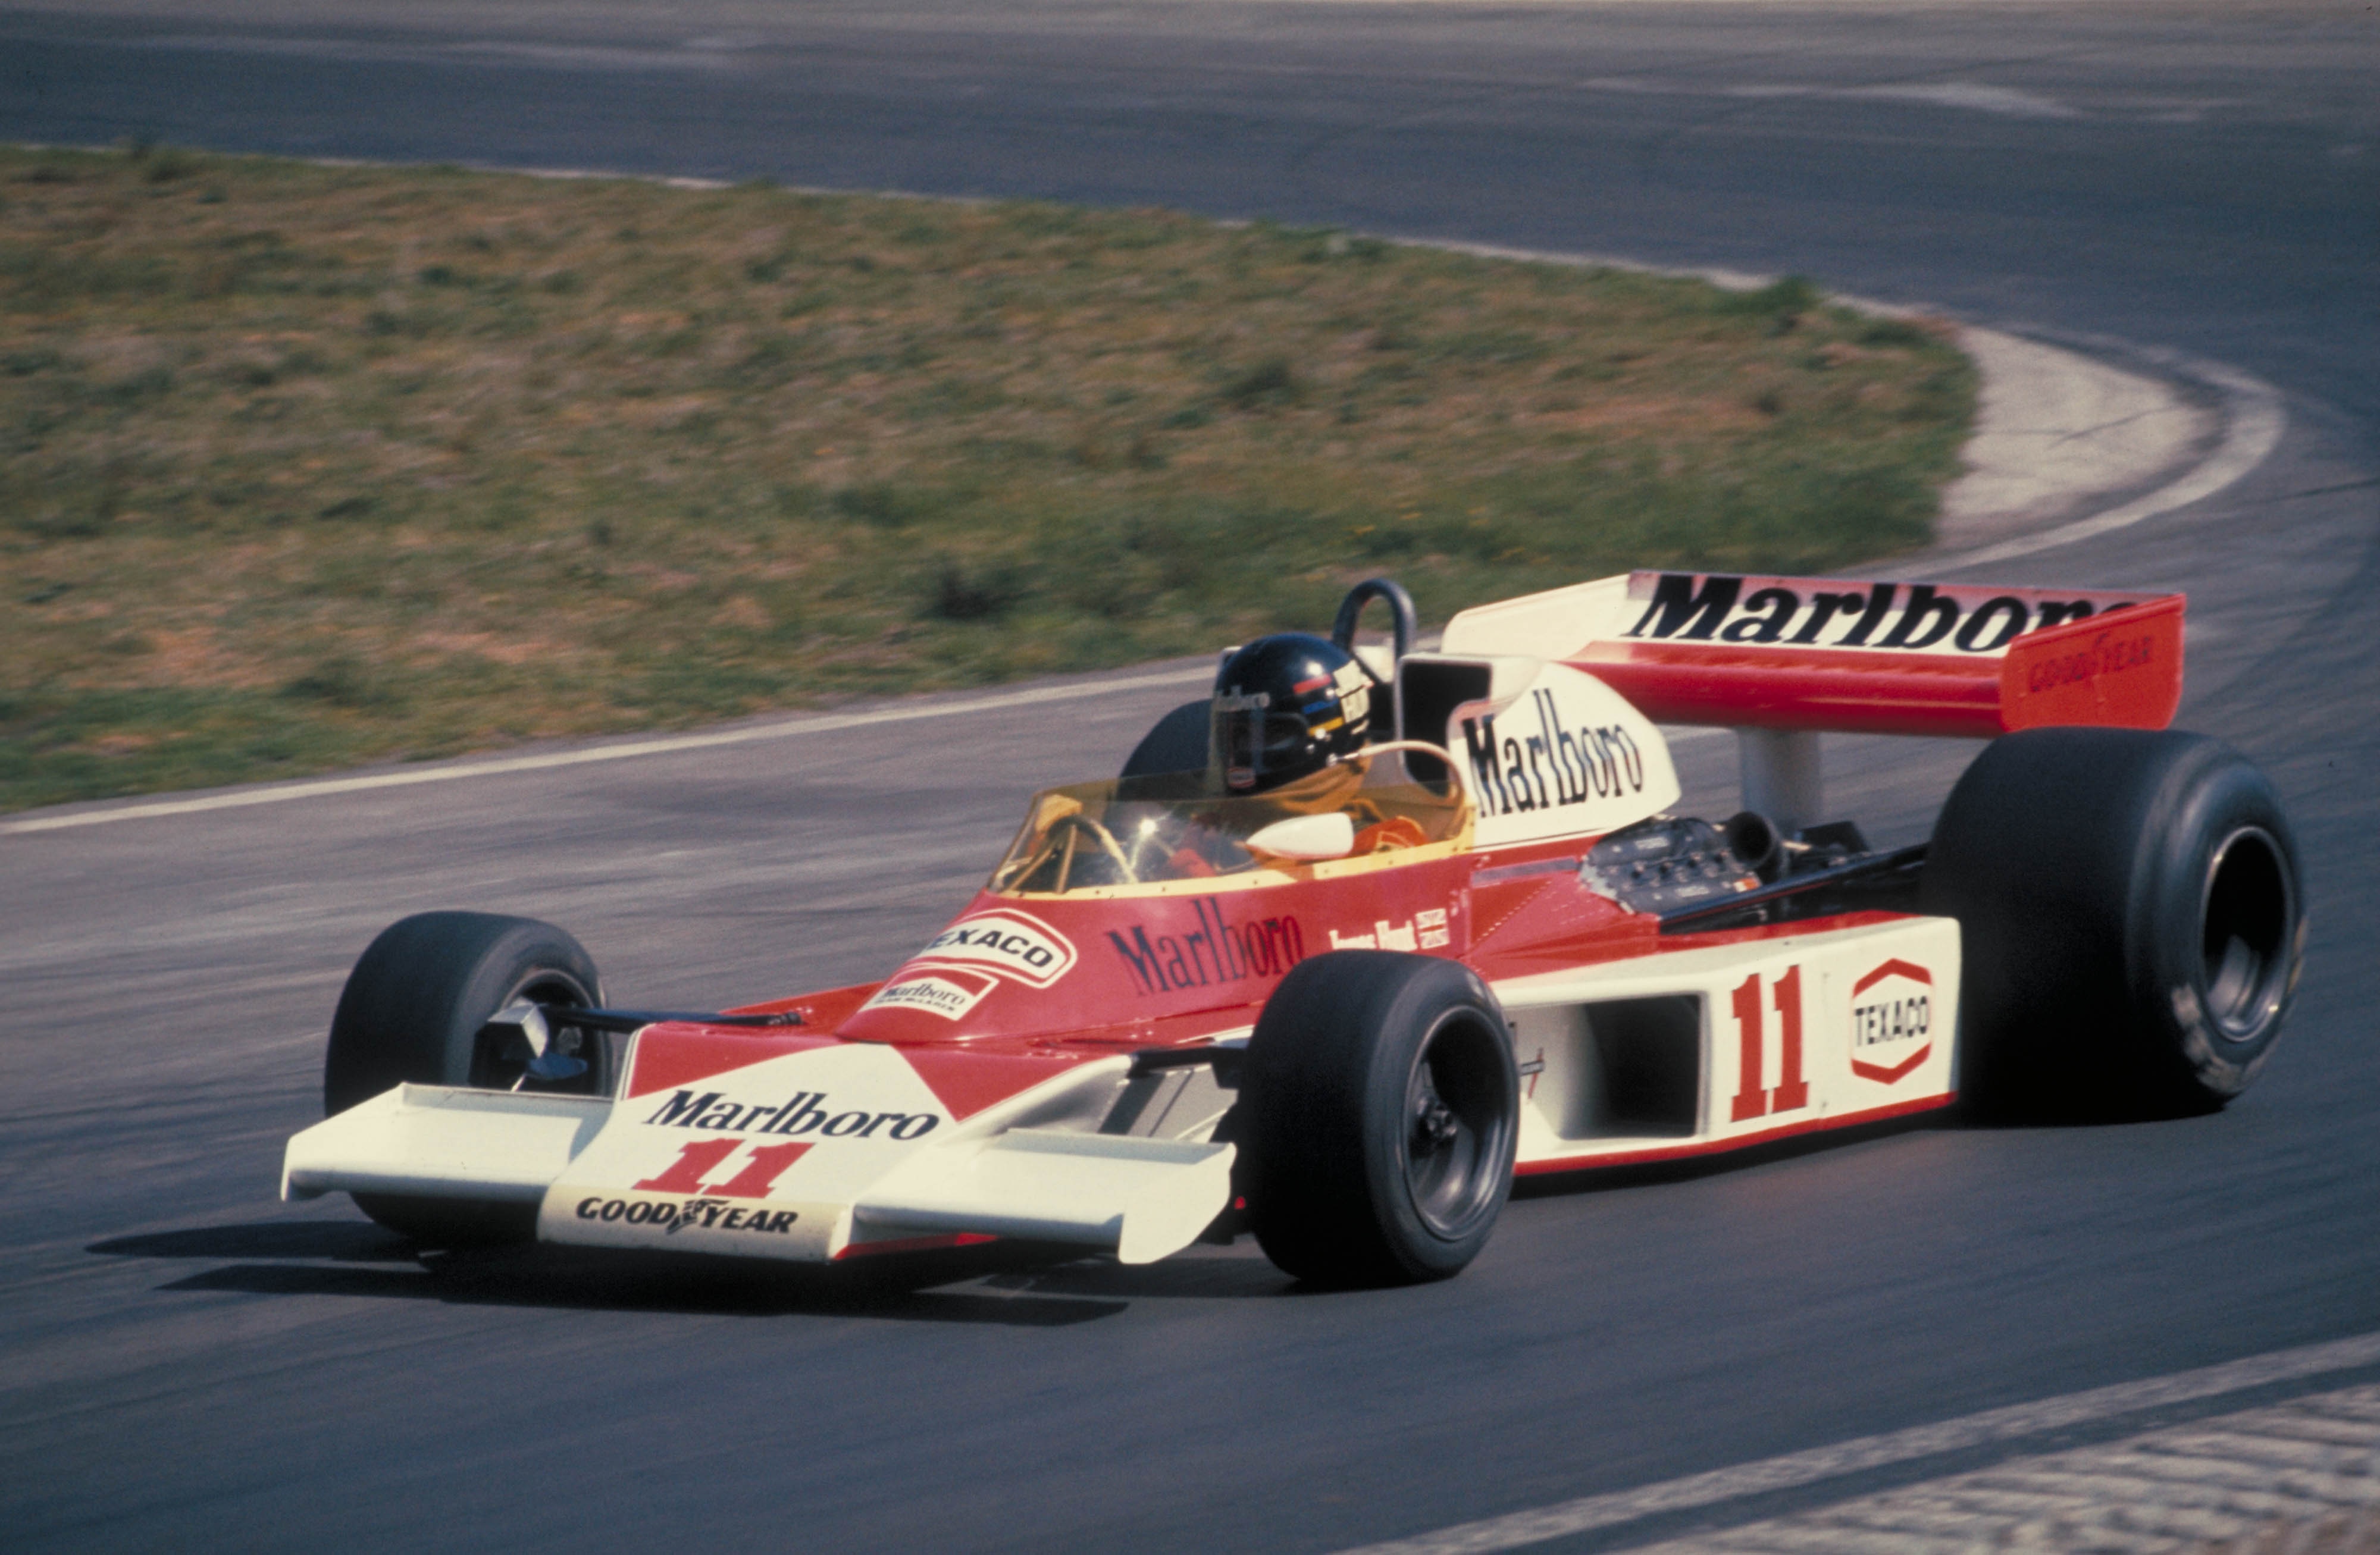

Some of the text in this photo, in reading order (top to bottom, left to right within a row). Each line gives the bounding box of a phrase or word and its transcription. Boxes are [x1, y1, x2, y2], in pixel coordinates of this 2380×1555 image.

[1620, 576, 2138, 652] Marlbor
[1462, 688, 1642, 817] Marlboro
[927, 928, 1053, 967] EXACO
[1106, 896, 1304, 996] Marlboro
[1731, 964, 1809, 1123] 11
[1855, 996, 1929, 1046] TEXACO
[642, 1090, 940, 1140] Marlboro
[631, 1138, 818, 1198] 11
